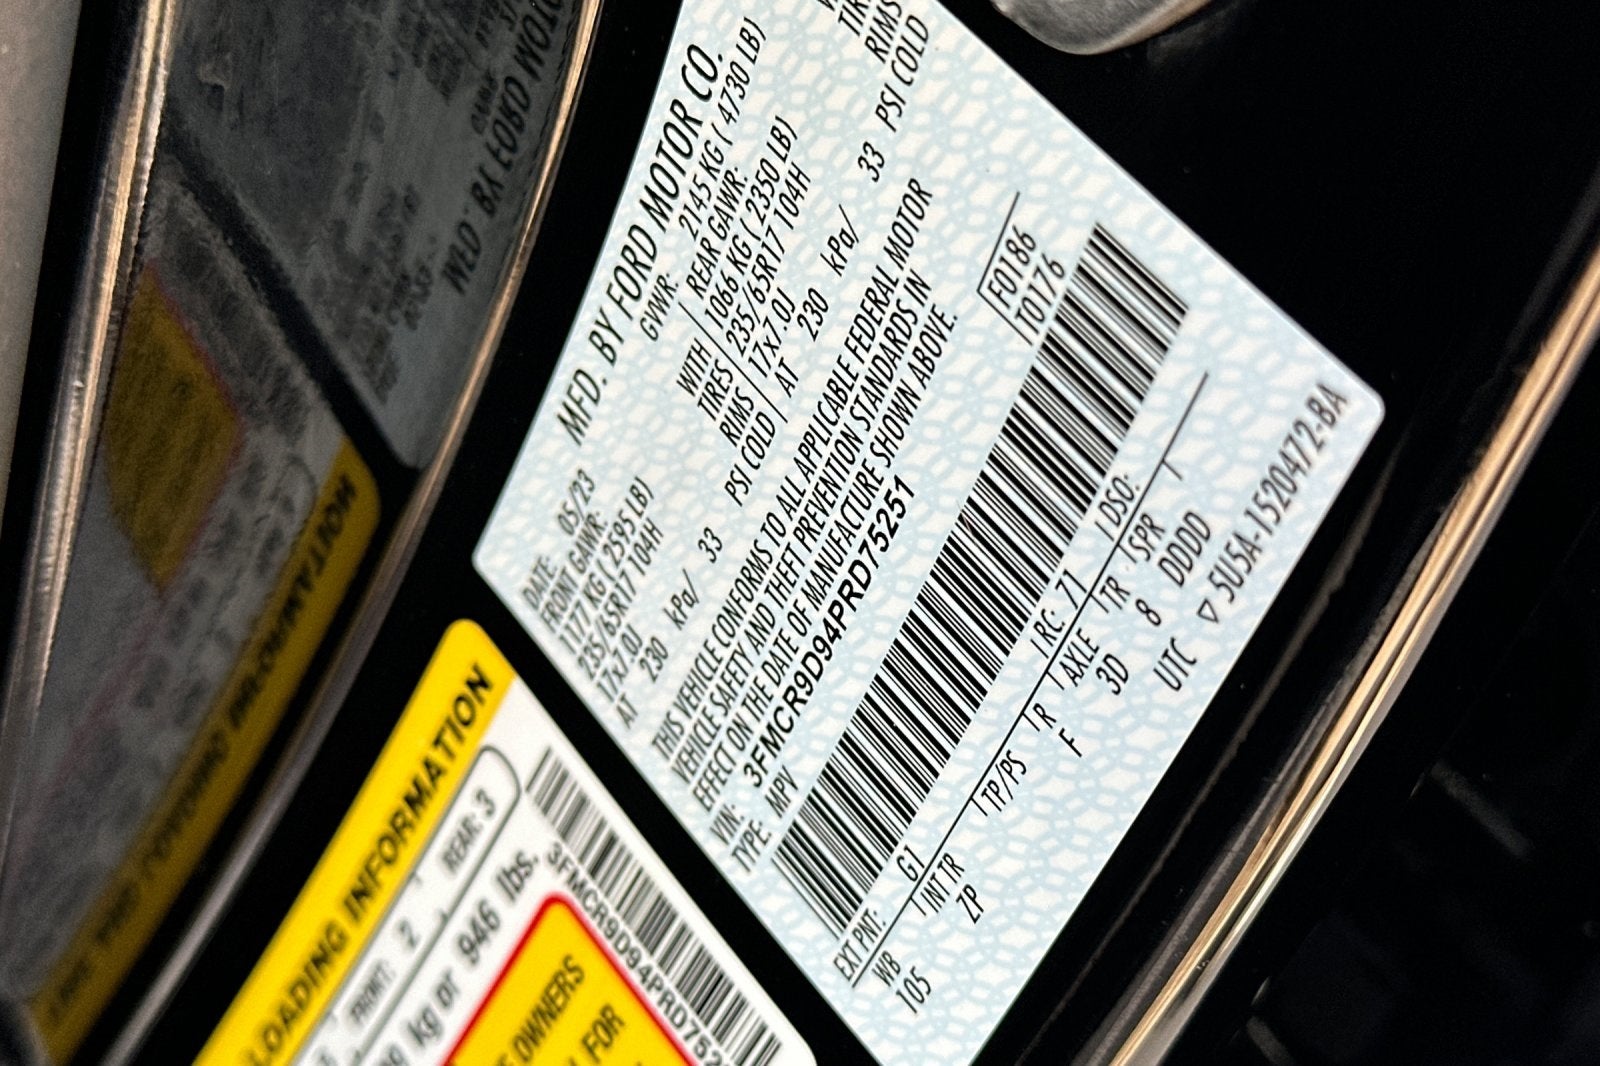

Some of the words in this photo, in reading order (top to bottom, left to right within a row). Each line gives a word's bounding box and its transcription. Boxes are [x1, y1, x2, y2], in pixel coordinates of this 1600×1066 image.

[838, 0, 871, 37] TIR
[864, 0, 902, 64] RIMS
[640, 273, 679, 342] GVWR:
[678, 173, 712, 242] 2145
[698, 139, 724, 182] KG
[717, 60, 750, 125] 4730
[736, 16, 766, 65] LB)
[774, 356, 799, 399] AT
[797, 287, 829, 342] 230
[820, 204, 859, 277] kPa/
[857, 141, 885, 183] 33
[875, 82, 906, 133] PSI
[891, 14, 929, 87] COLD
[557, 368, 607, 446] MFD.
[588, 306, 624, 367] BY
[606, 224, 657, 321] FORD
[639, 98, 703, 234] MOTOR
[681, 44, 723, 102] CO.
[686, 237, 721, 300] REAR
[707, 166, 748, 241] GAWR:
[704, 269, 739, 330] 1066
[726, 234, 752, 276] KG
[745, 158, 780, 227] 2350
[766, 115, 798, 164] LB)
[726, 224, 785, 358] 235/65R17
[773, 161, 811, 230] 104H
[676, 337, 712, 397] WITH
[748, 287, 796, 378] 17x7.0J
[697, 358, 733, 421] TIRES
[719, 386, 754, 448] RIMS
[652, 711, 684, 760] THIS
[673, 639, 723, 719] VEHICLE
[711, 538, 773, 648] CONFORMS
[760, 512, 786, 548] TO
[776, 475, 807, 522] ALL
[793, 354, 859, 484] APPLICABLE
[844, 264, 900, 365] FEDERAL
[883, 178, 933, 271] MOTOR
[1098, 475, 1140, 528] DSO:
[522, 558, 554, 610] DATE:
[557, 469, 595, 536] 05/23
[559, 600, 590, 654] 1177
[583, 572, 606, 609] KG
[602, 509, 636, 568] 2595
[625, 476, 654, 518] LB)
[672, 706, 722, 784] VEHICLE
[709, 641, 754, 717] SAFETY
[744, 602, 776, 656] AND
[764, 541, 806, 610] THEFT
[792, 422, 864, 554] PREVENTION
[849, 298, 918, 432] STANDARDS
[903, 268, 932, 308] IN
[692, 741, 736, 812] EFFECT
[726, 712, 754, 752] ON
[741, 676, 774, 723] THE
[761, 627, 800, 688] DATE
[787, 598, 812, 637] OF
[800, 457, 884, 612] MANUFACTURE
[869, 378, 921, 469] SHOWN
[907, 303, 958, 390] ABOVE.
[1128, 512, 1166, 562] SPR
[1157, 511, 1211, 588] DDDD
[540, 567, 577, 633] FRONT
[568, 513, 607, 574] GAWR:
[577, 569, 636, 680] 235/65R17
[627, 517, 663, 576] 104H
[617, 694, 637, 728] AT
[639, 636, 668, 683] 230
[663, 568, 699, 631] kPa/
[698, 527, 723, 564] 33
[724, 463, 753, 507] PSI
[741, 411, 776, 470] COLD
[1033, 608, 1066, 647] RC:
[1055, 568, 1087, 612] 71
[1099, 575, 1131, 610] TR
[1135, 598, 1162, 627] 8
[597, 624, 643, 702] 17x7.0J
[710, 804, 744, 845] VIN:
[743, 474, 915, 788] 3FMCR9D94PRD75251
[1059, 627, 1100, 687] AXLE
[1095, 653, 1129, 696] 3D
[1153, 637, 1197, 692] UTC
[1032, 703, 1057, 729] R
[1058, 727, 1082, 758] F
[731, 820, 772, 872] TYPE:
[765, 765, 798, 819] MPV
[981, 749, 1027, 812] TP/PS
[249, 919, 348, 1066] LOADING
[342, 661, 494, 924] INFORMATION
[442, 812, 484, 873] REAR:
[475, 788, 497, 820] 3
[920, 872, 950, 914] INT
[937, 852, 965, 884] TR
[955, 884, 984, 924] ZP
[398, 917, 420, 950] 2
[406, 1010, 443, 1050] kg
[436, 972, 463, 1008] or
[457, 901, 501, 965] 946
[497, 850, 539, 901] lbs.
[546, 848, 730, 1066] 3FMCR9D94PRD752
[833, 939, 862, 982] EXT
[852, 908, 886, 952] PNT:
[872, 951, 901, 987] WB
[512, 954, 587, 1064] OWNERS
[896, 966, 931, 1014] 105
[581, 1002, 626, 1064] FOR
